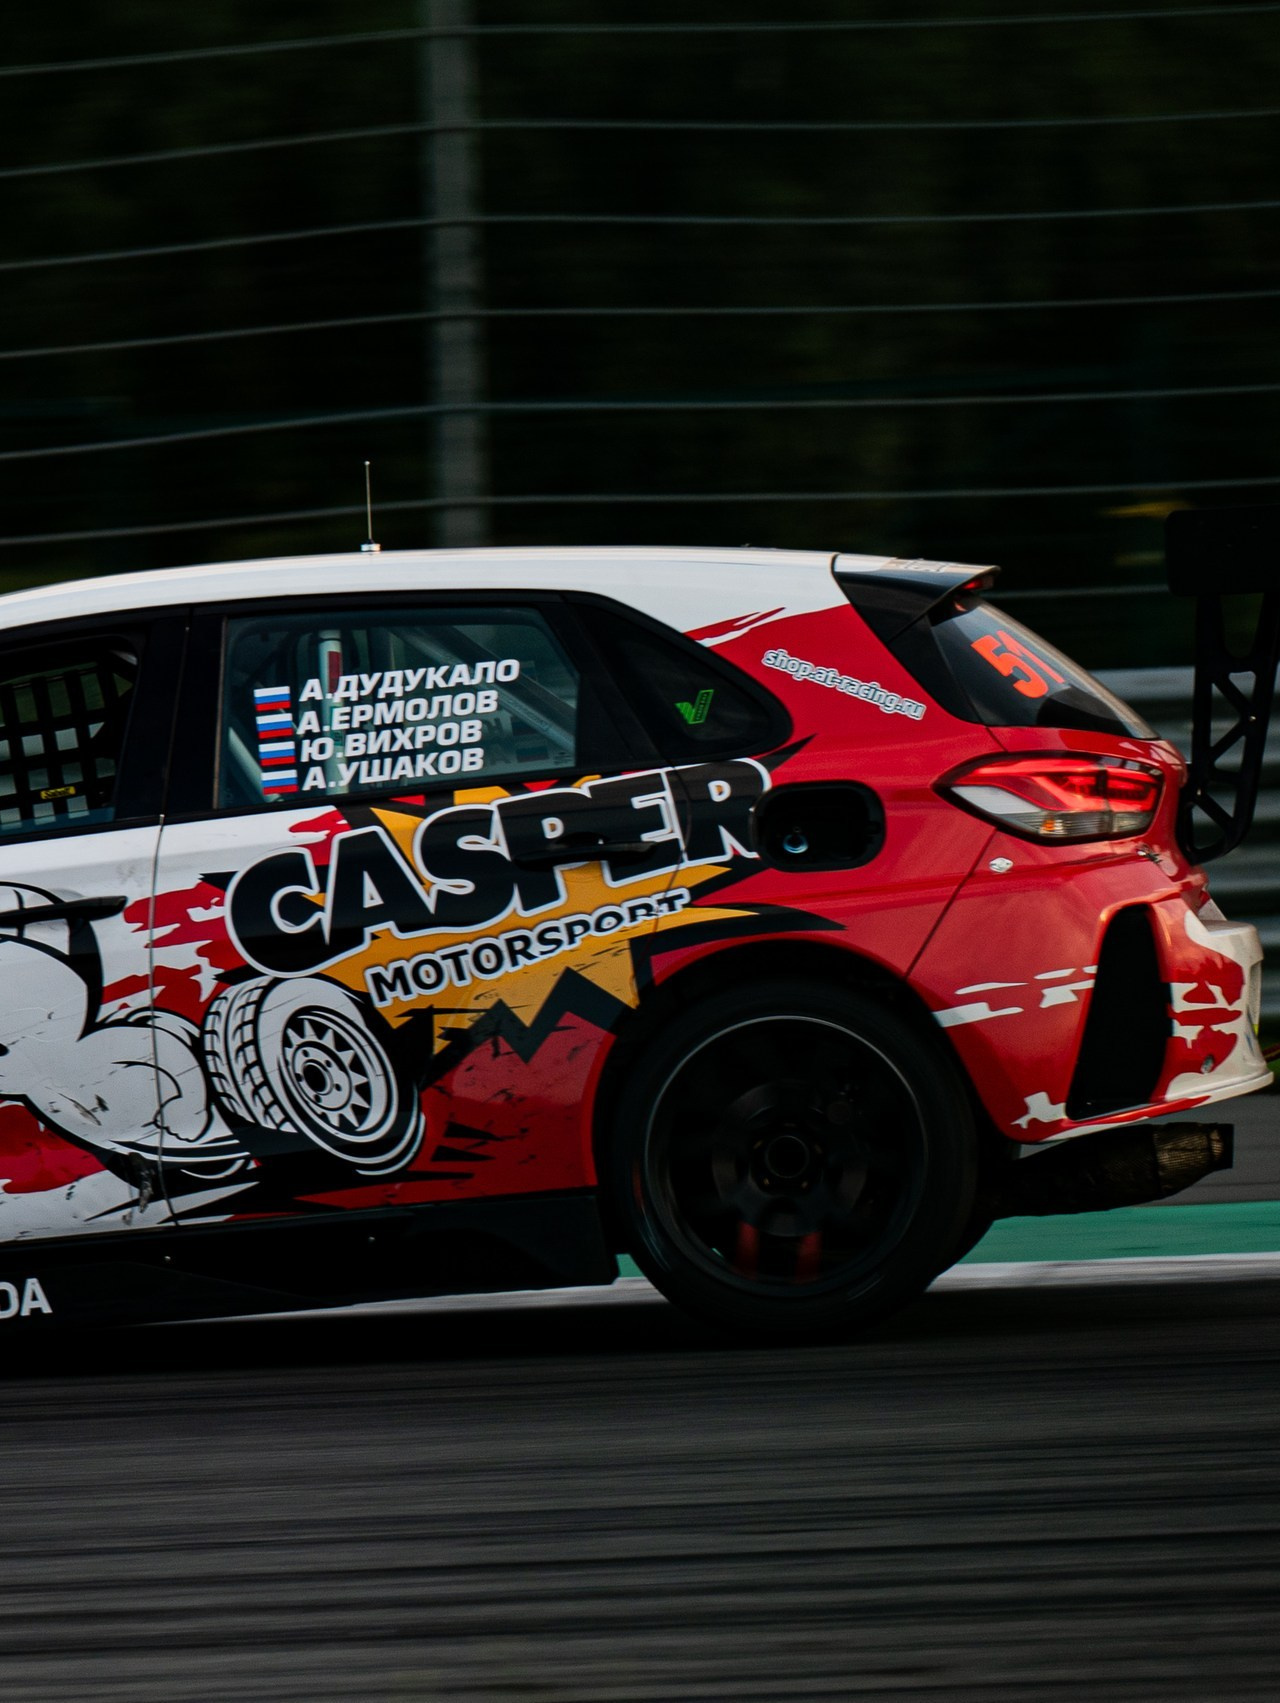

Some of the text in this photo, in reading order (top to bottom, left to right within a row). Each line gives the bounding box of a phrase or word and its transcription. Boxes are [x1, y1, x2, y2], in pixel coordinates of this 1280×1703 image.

[299, 659, 520, 702] А.ДУДУКАЛО
[761, 648, 927, 721] shop.at-racing.ru
[970, 630, 1066, 699] 51
[296, 690, 498, 735] А.ЕРМОЛОВ
[300, 719, 482, 763] Ю.ВИХРОВ
[301, 747, 484, 791] А.УШАКОВ
[224, 757, 773, 978] CASPER
[363, 886, 692, 1008] MOTORSPORT
